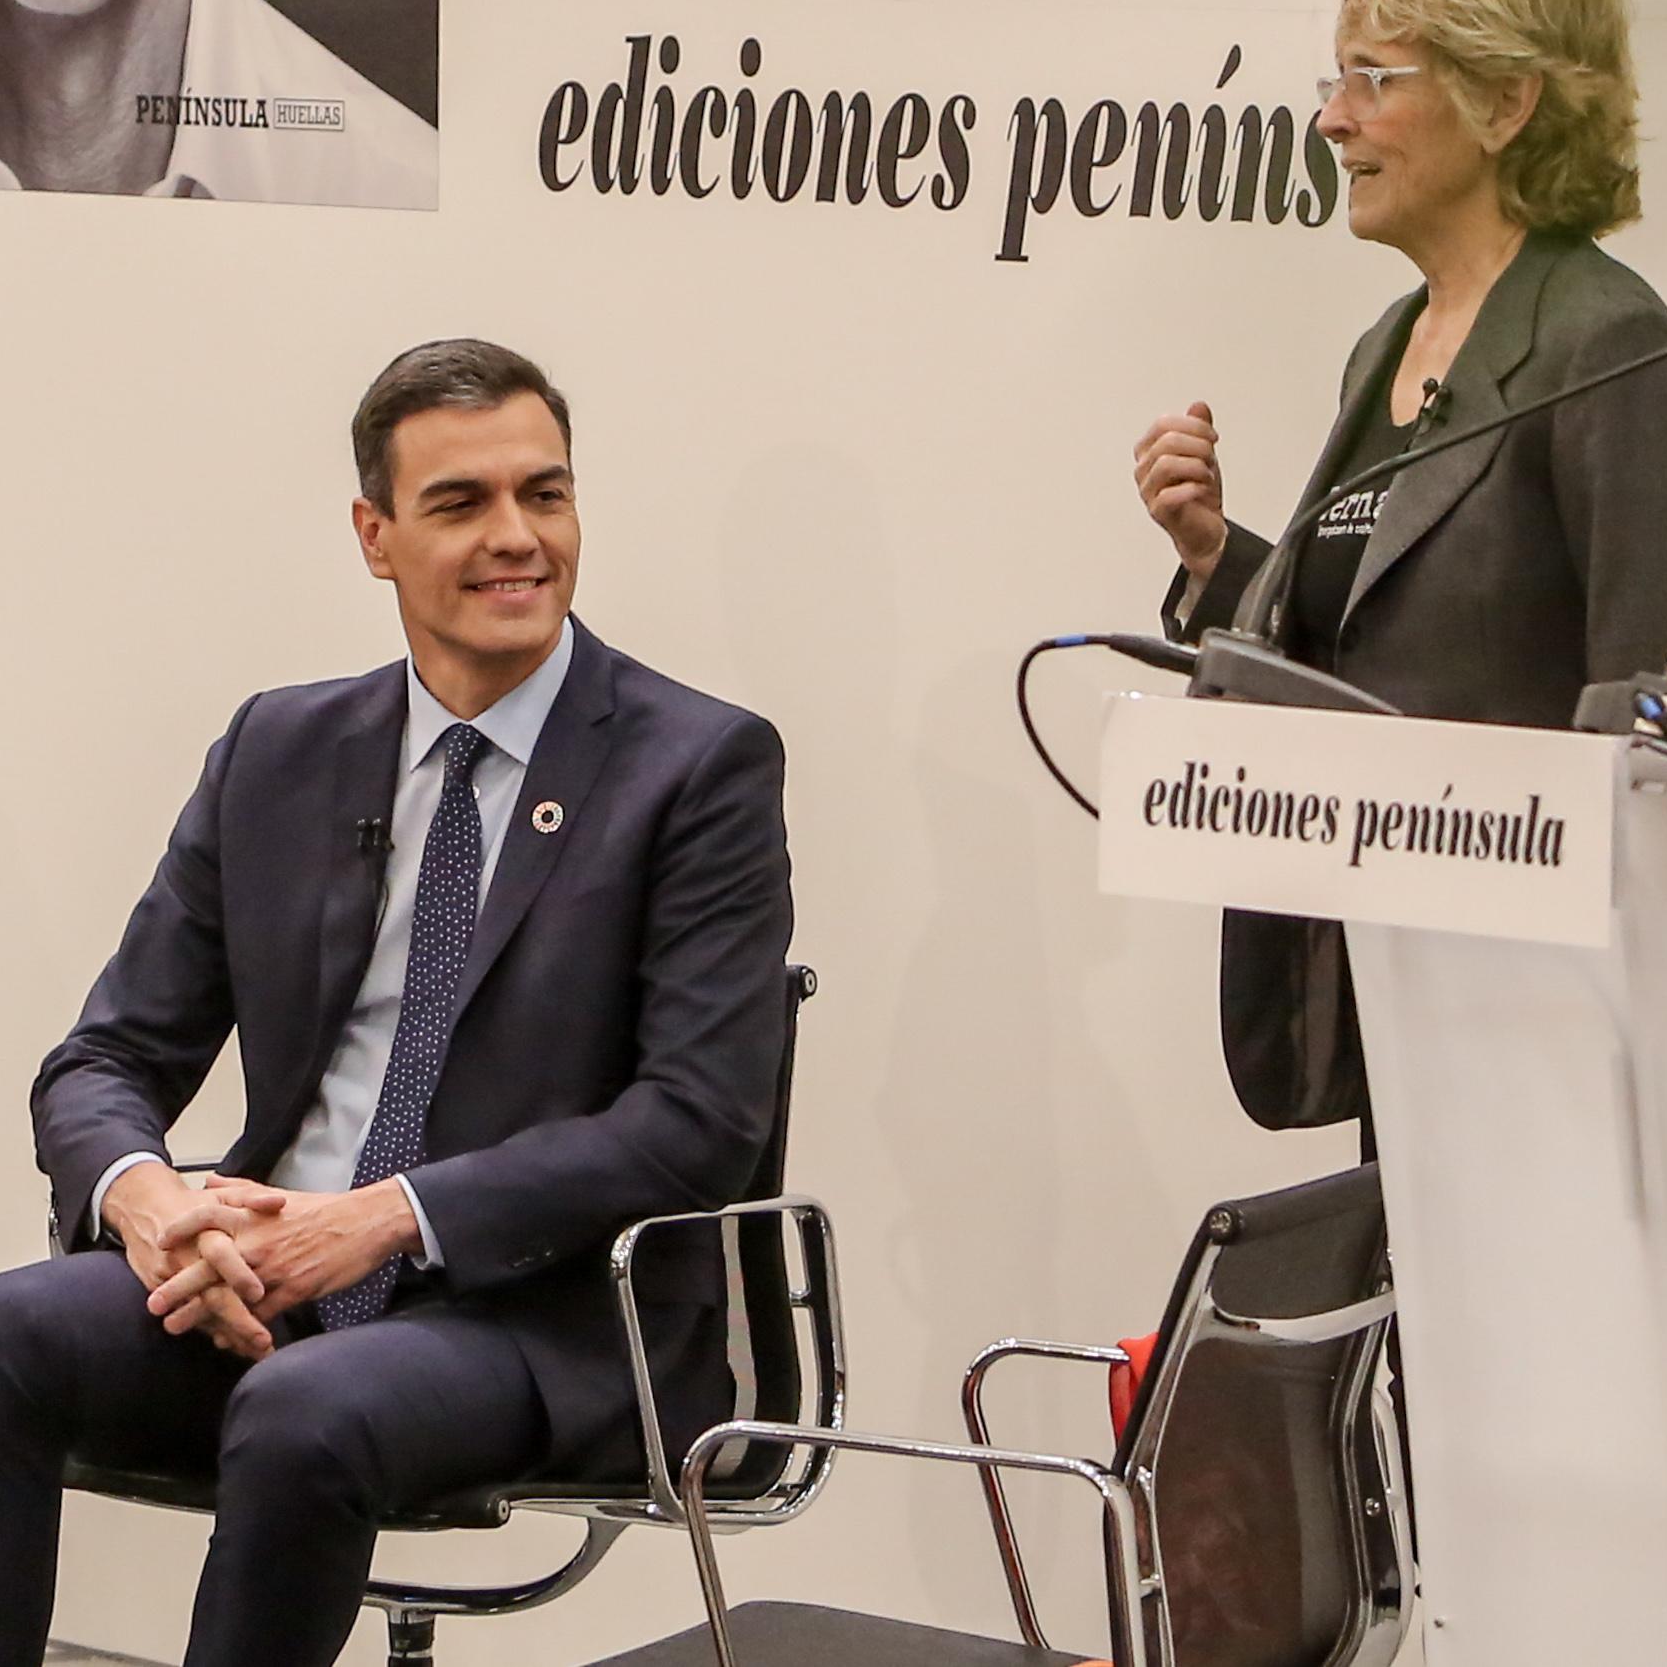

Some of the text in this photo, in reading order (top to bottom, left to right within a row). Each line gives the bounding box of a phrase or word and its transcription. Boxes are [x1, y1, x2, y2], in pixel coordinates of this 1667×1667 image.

[134, 87, 342, 129] PENÍNSULA HUELLAS
[536, 34, 1338, 264] ediciones peníns
[1143, 760, 1566, 868] ediciones península
